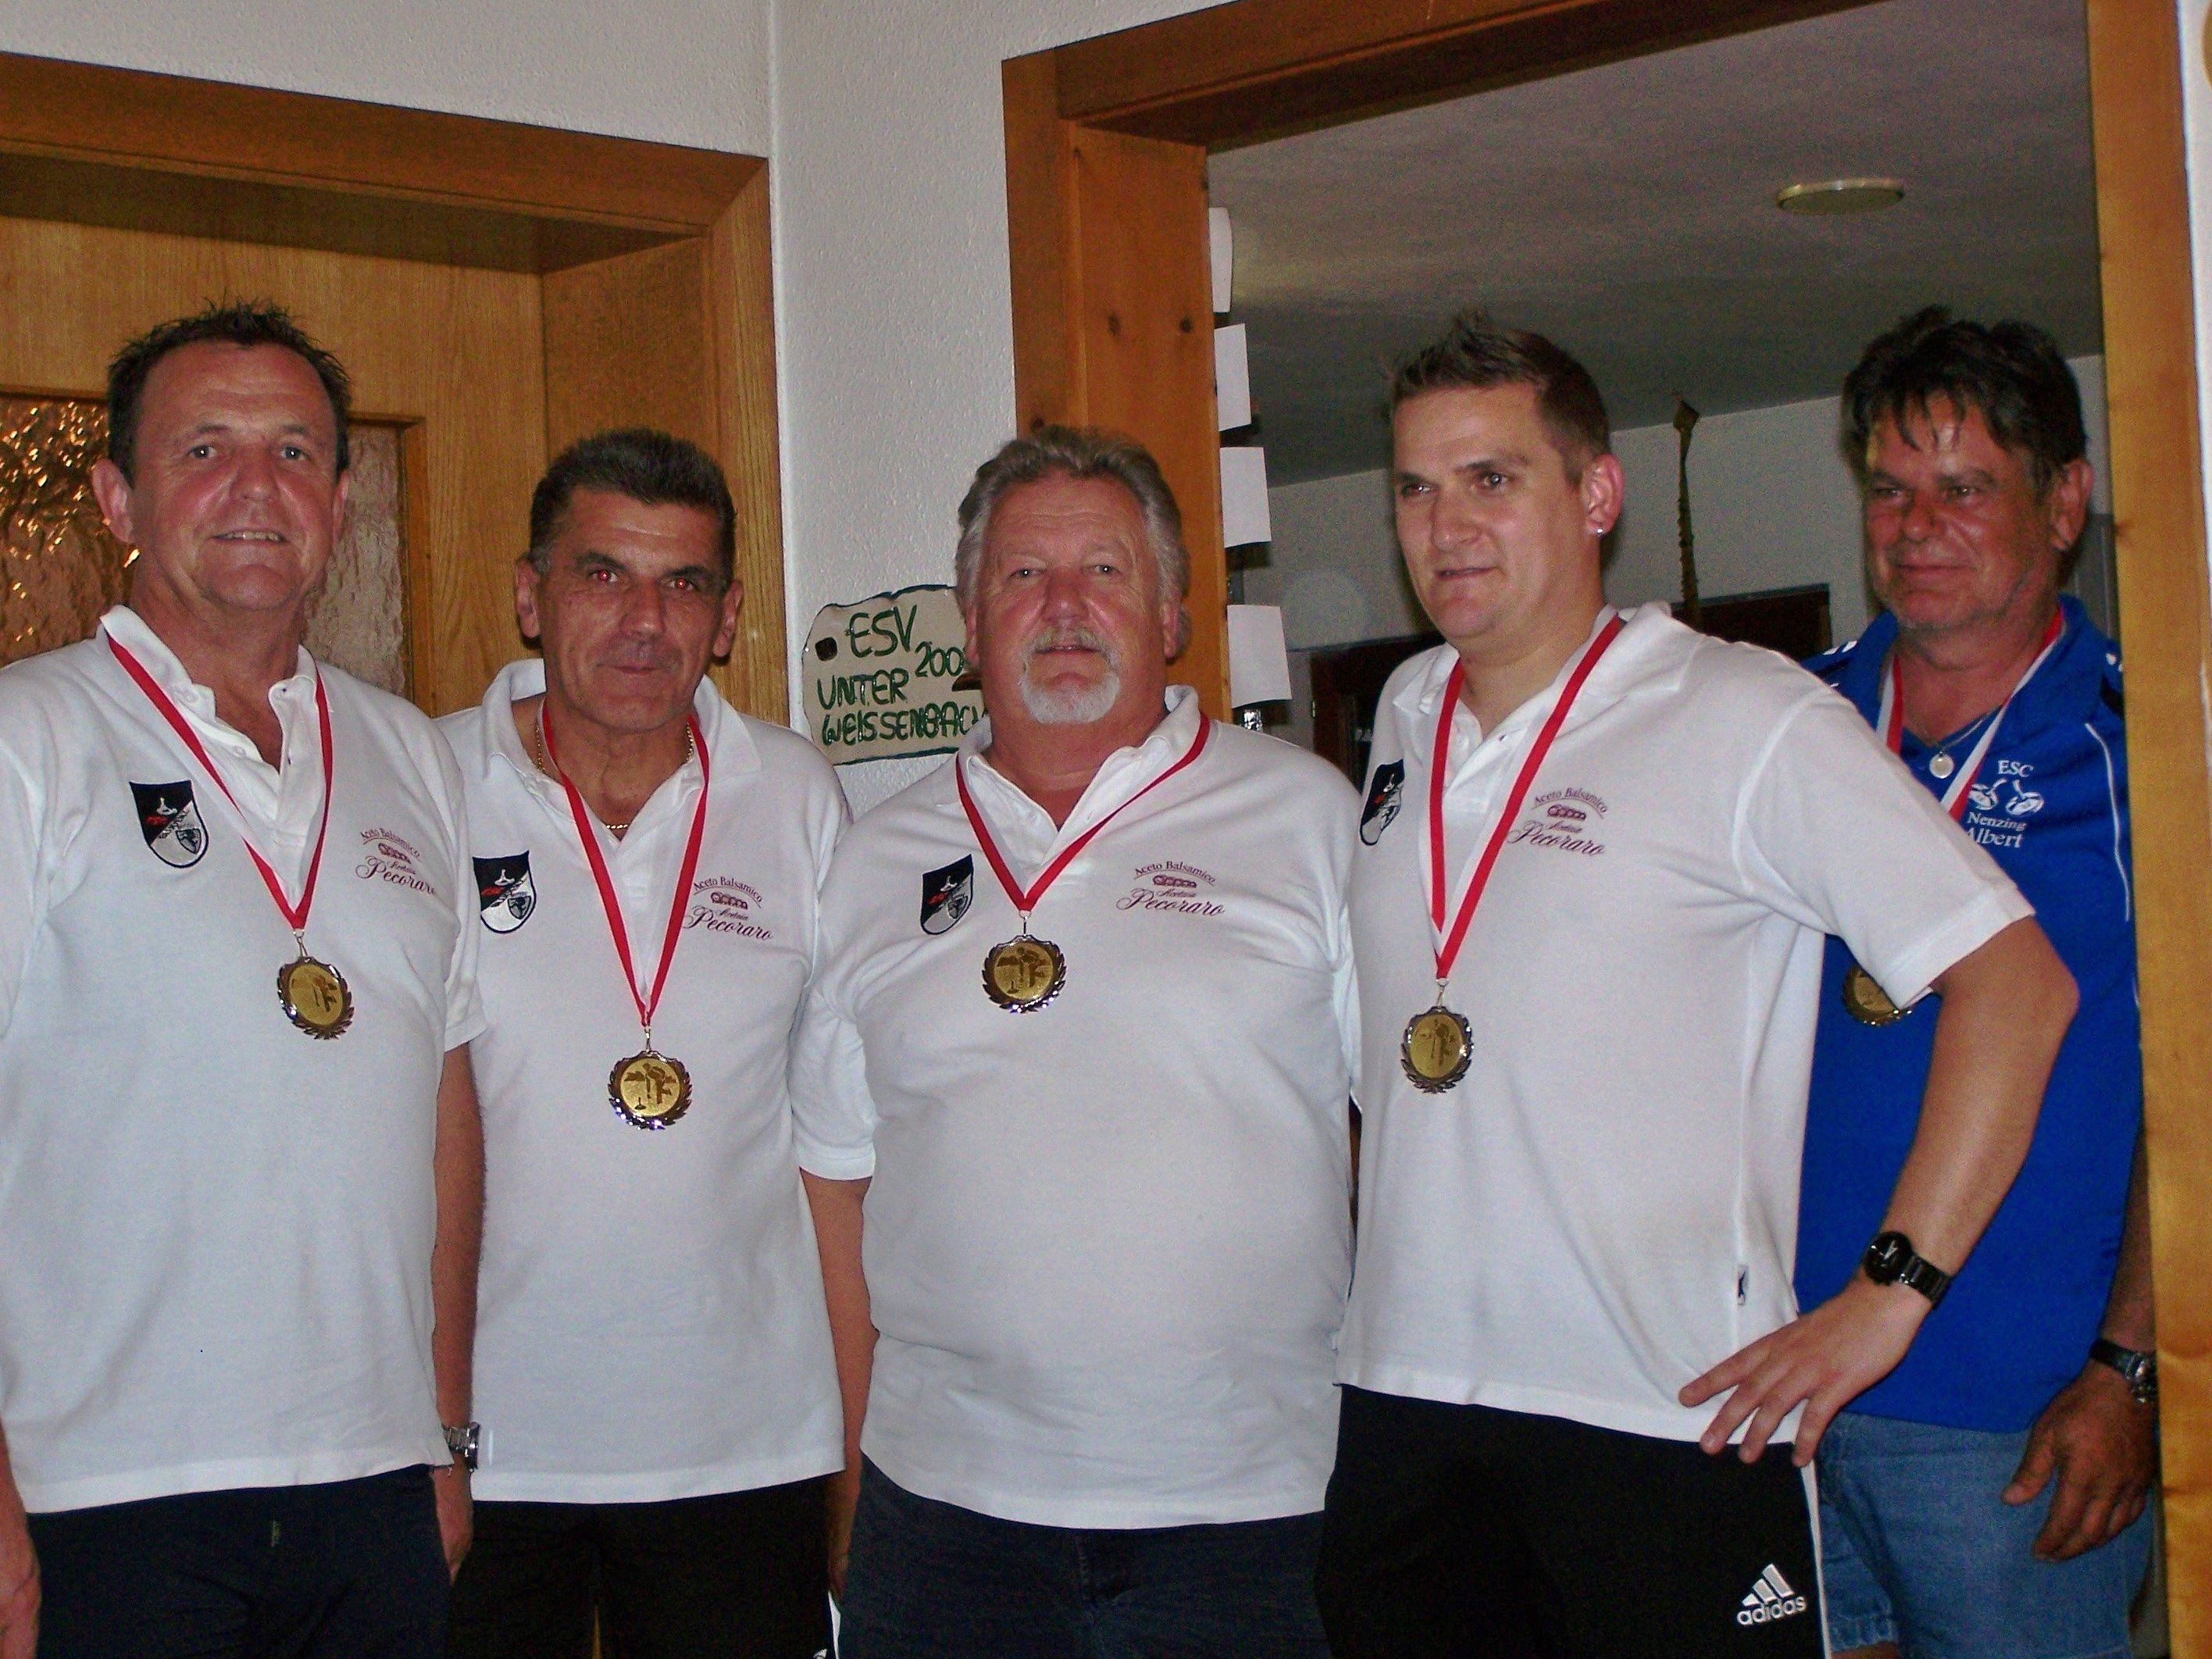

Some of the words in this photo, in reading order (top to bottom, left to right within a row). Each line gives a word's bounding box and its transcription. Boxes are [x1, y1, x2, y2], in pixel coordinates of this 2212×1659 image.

[847, 605, 918, 658] ESV
[915, 640, 966, 678] 200
[817, 668, 908, 710] UNTER
[1996, 759, 2034, 778] ESC
[1966, 811, 2028, 833] Nenzing
[1115, 887, 1226, 917] Pecoraro
[681, 904, 774, 941] Pecoraro
[1736, 1596, 1807, 1626] adidas
